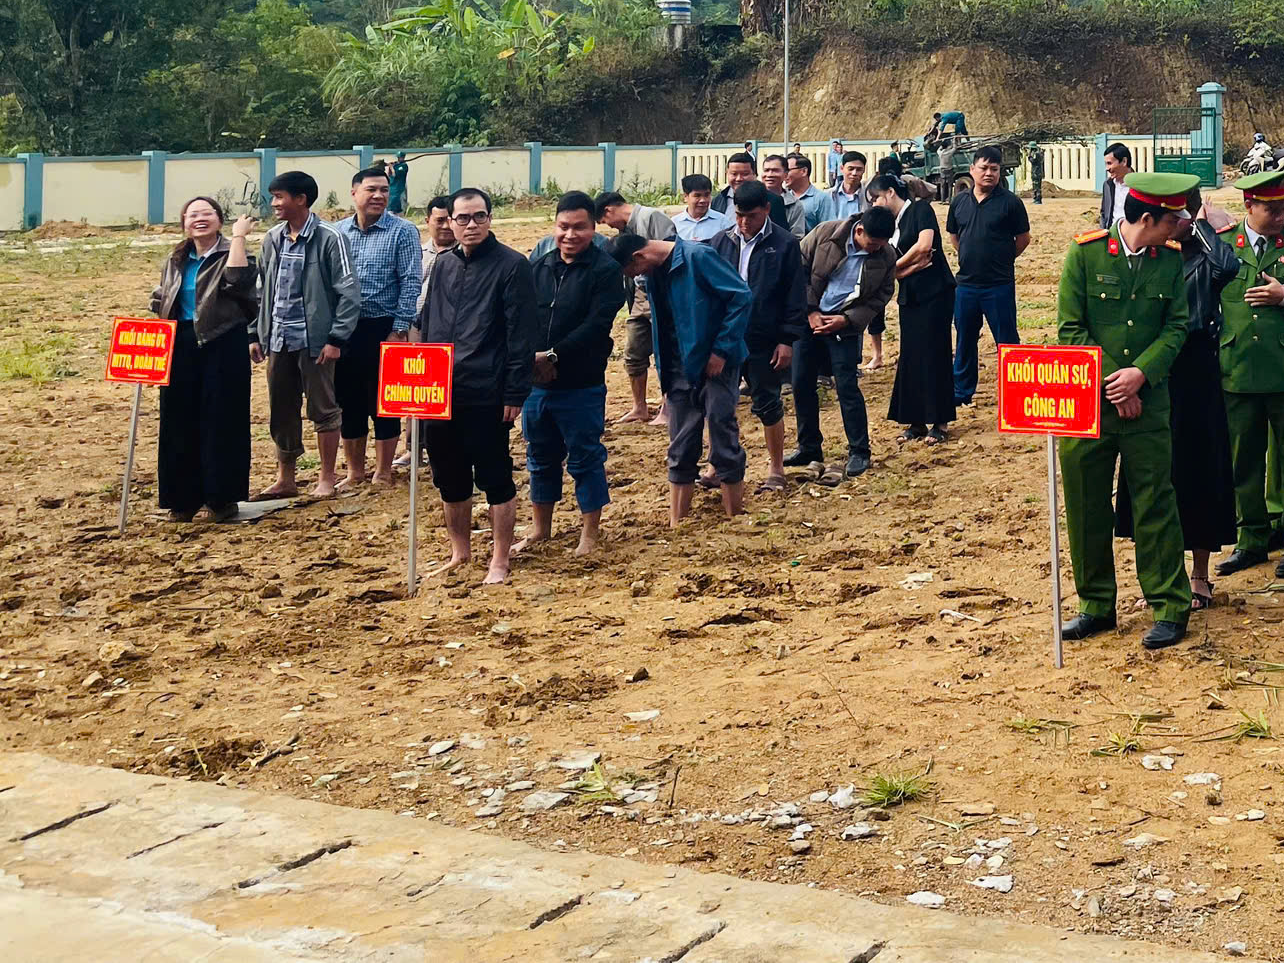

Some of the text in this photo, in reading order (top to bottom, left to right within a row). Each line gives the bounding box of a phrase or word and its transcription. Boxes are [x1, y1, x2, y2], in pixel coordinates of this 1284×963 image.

[403, 352, 425, 374] KHỐI
[1007, 356, 1092, 389] KHỐI QUÂN SỰ,
[384, 382, 412, 402] CHÍNH
[1023, 393, 1075, 419] CÔNG AN
